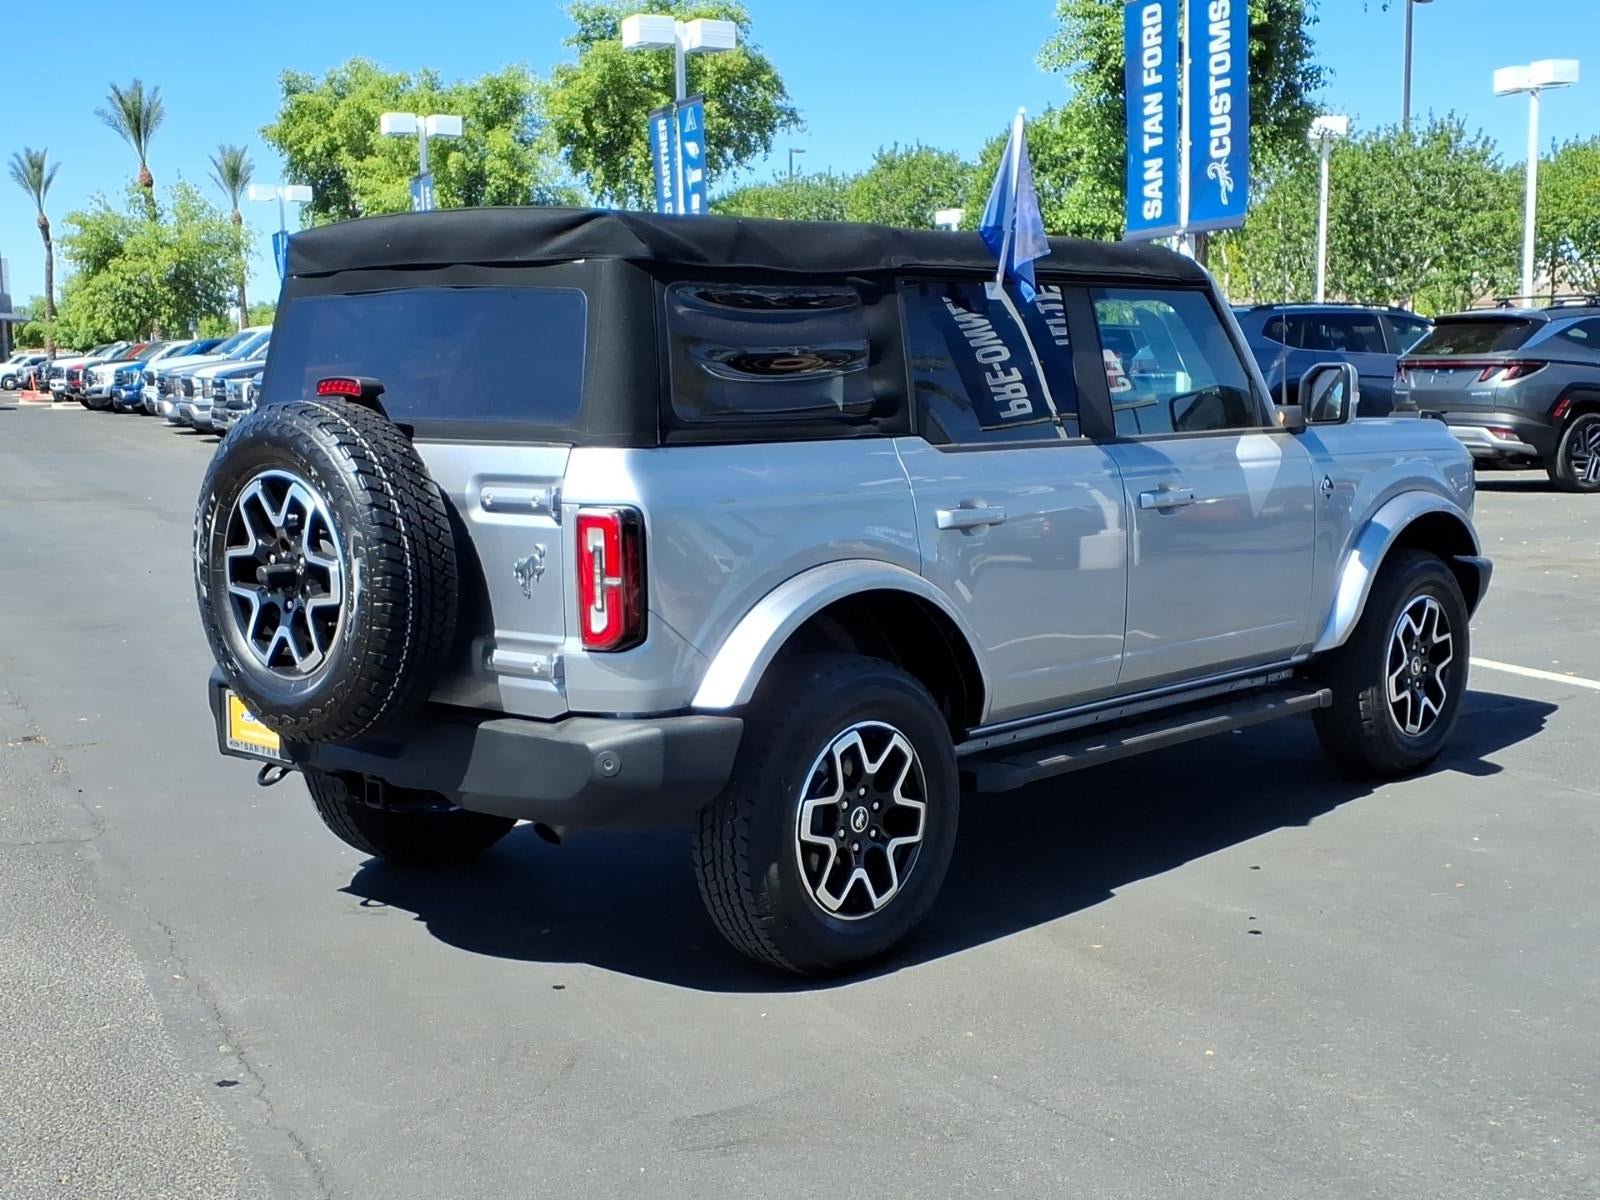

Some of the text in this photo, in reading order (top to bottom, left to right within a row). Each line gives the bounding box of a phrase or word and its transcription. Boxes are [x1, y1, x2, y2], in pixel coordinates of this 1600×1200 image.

[658, 119, 672, 199] PARTNER
[1142, 2, 1164, 221] SAN TAN FORD
[1209, 0, 1231, 159] CUSTOMS
